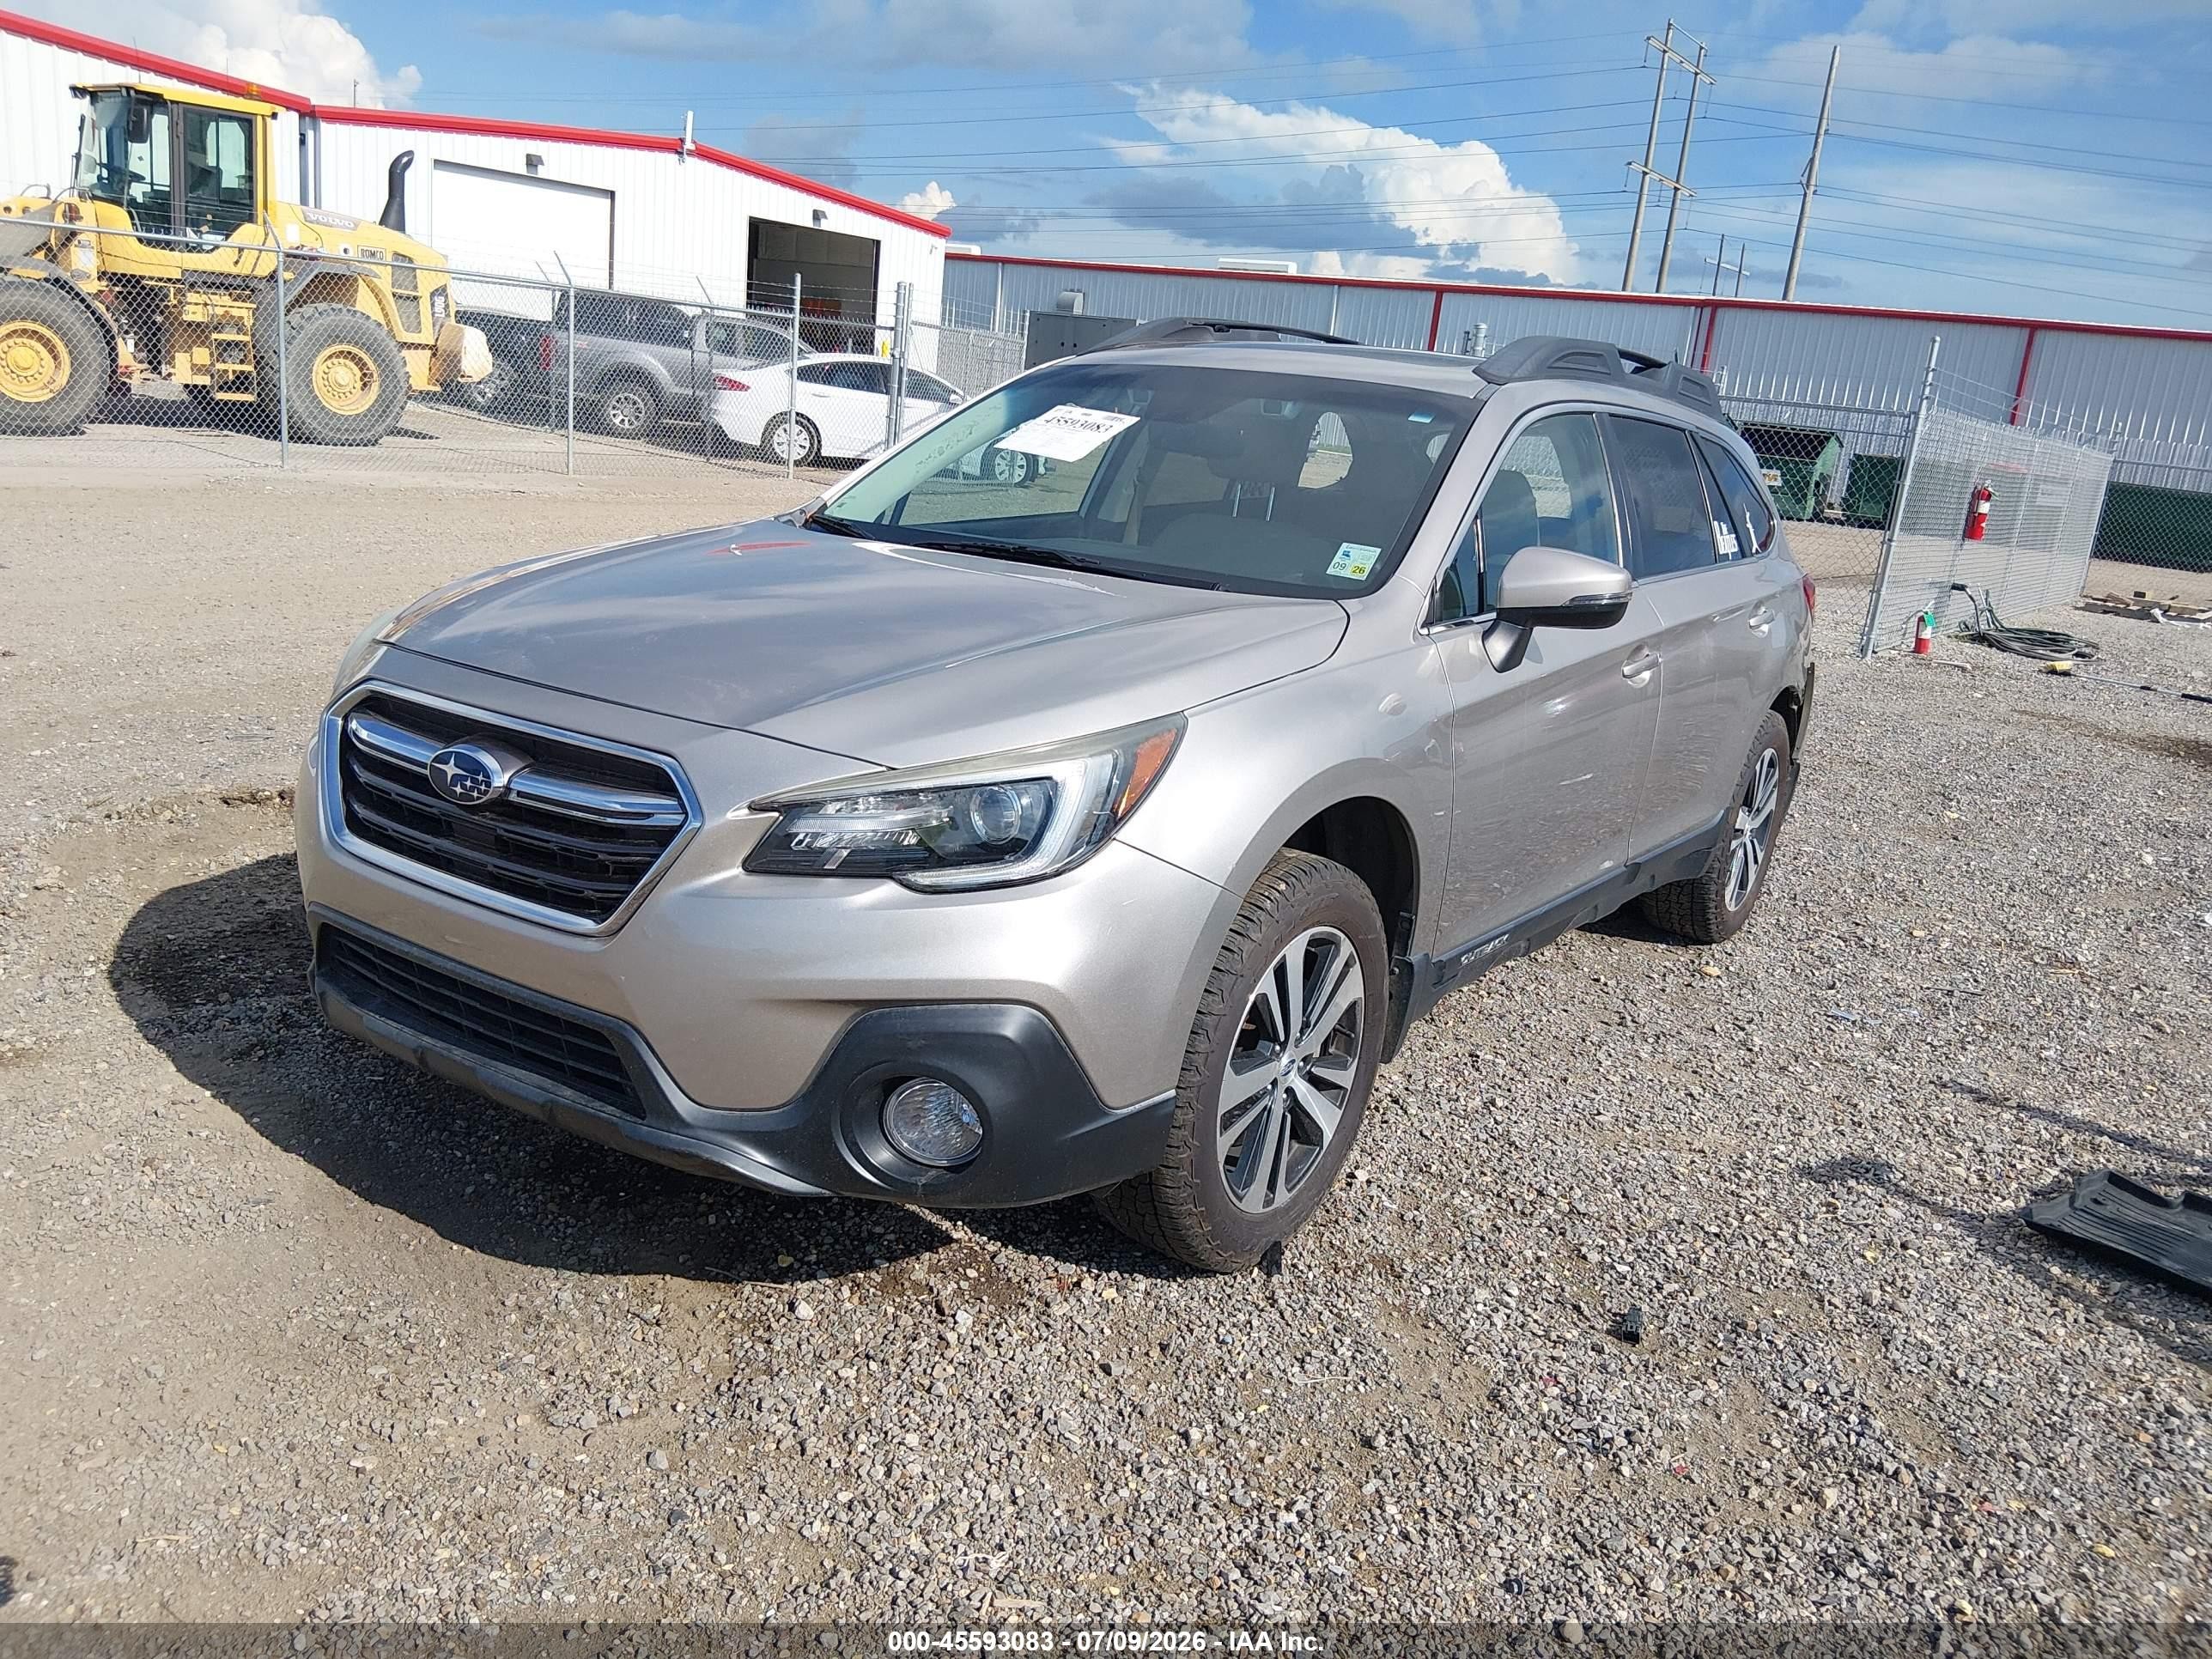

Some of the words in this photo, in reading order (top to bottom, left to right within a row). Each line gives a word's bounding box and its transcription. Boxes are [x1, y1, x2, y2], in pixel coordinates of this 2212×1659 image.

[307, 213, 355, 228] VOLVO
[361, 248, 384, 261] ROMCO
[1044, 416, 1114, 434] 45593083
[1333, 562, 1346, 571] 09
[1352, 565, 1366, 574] 26
